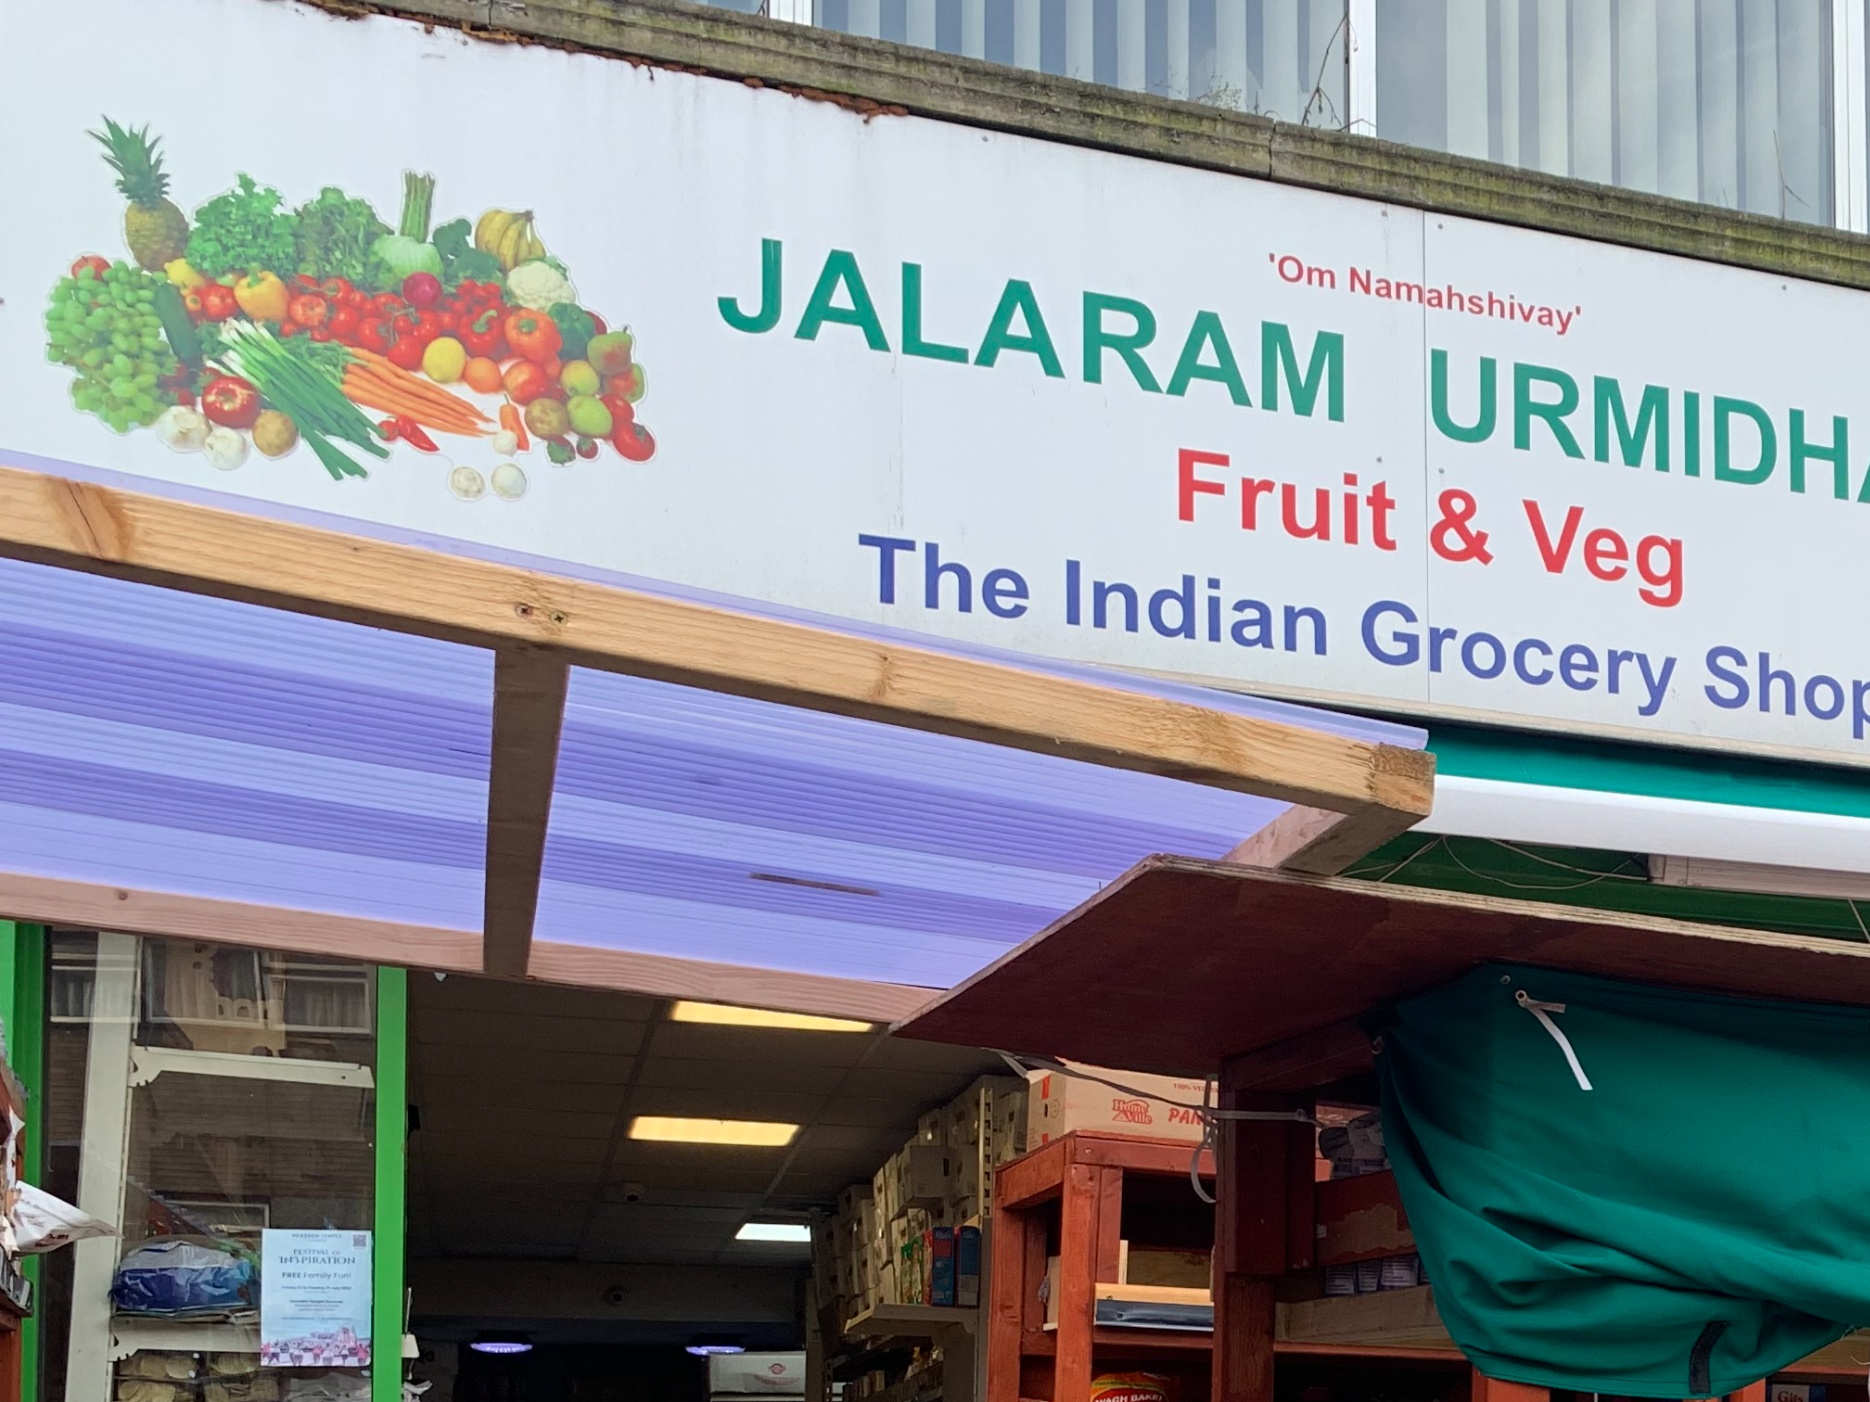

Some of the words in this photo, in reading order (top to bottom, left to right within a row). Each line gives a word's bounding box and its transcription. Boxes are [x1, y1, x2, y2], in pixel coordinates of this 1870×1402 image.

[717, 238, 1344, 423] JALARAM
[1350, 266, 1581, 336] Namahshivay'
[1178, 447, 1397, 551] Fruit
[1430, 489, 1494, 566] &
[1522, 499, 1684, 608] Veg
[857, 533, 1030, 619] The
[1065, 559, 1328, 656] Indian
[1361, 600, 1678, 718] Grocery
[278, 1255, 356, 1265] INSPIRATION
[281, 1271, 302, 1279] FREE
[1130, 1393, 1163, 1402] BAKRI
